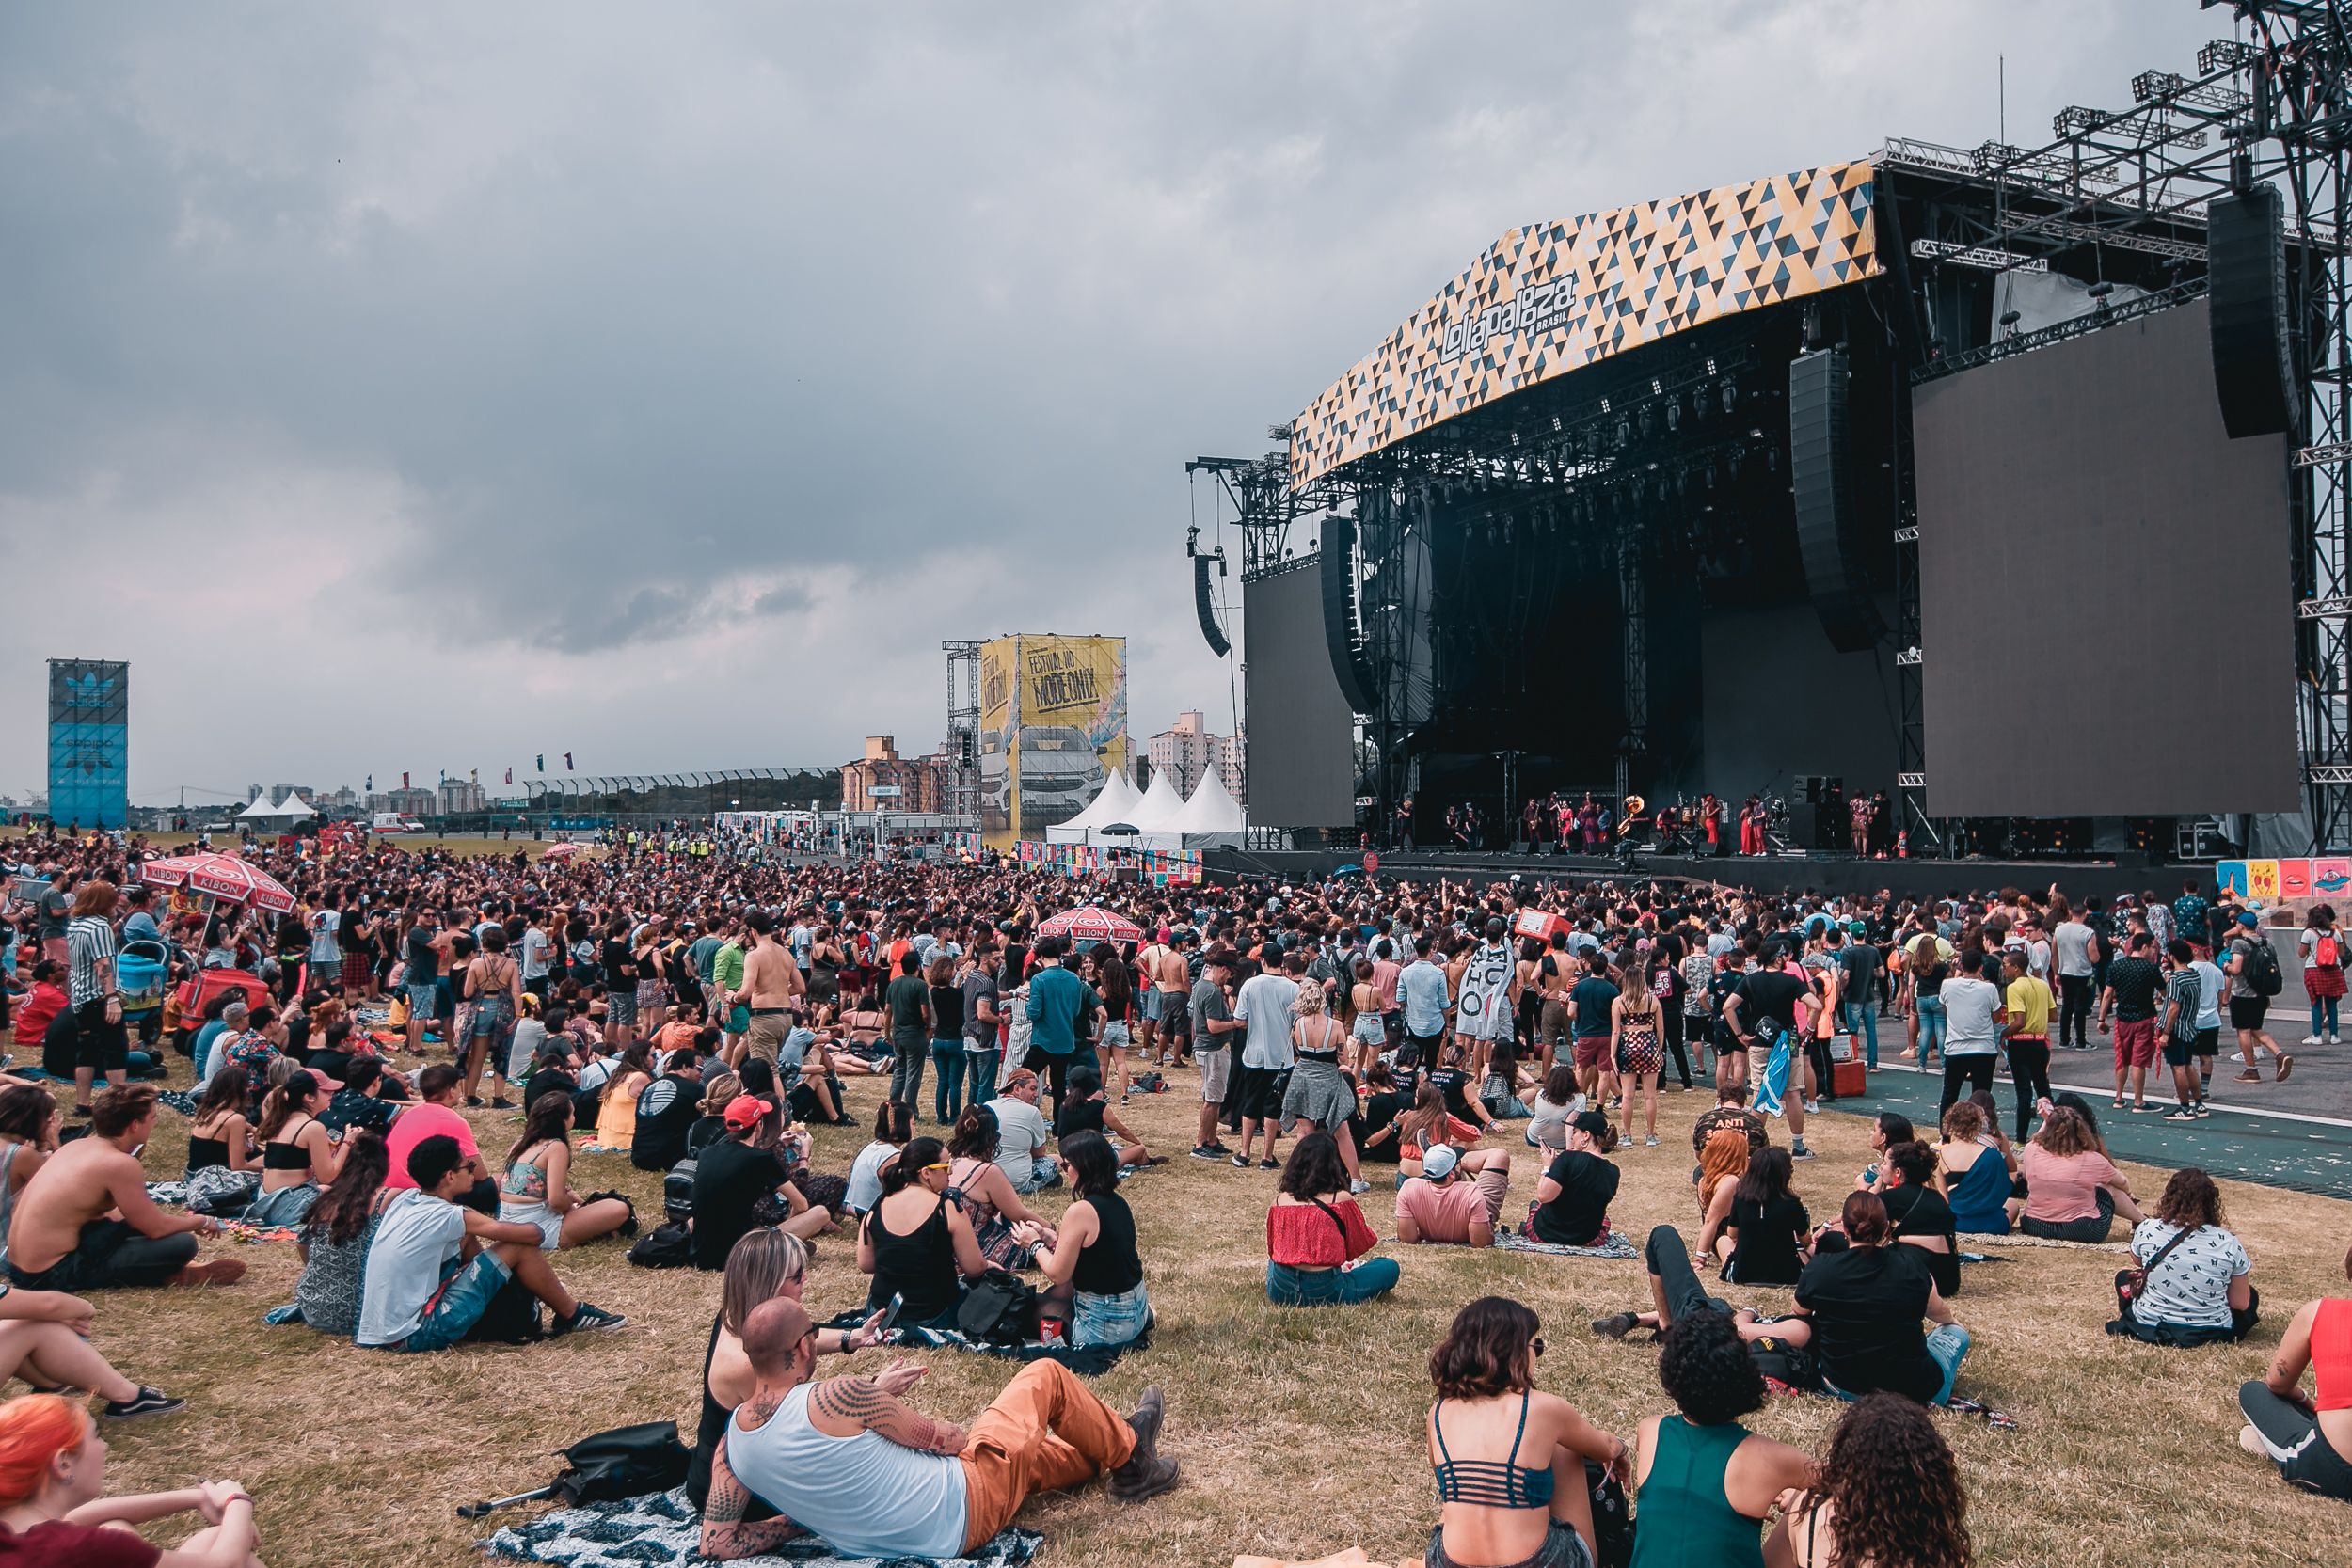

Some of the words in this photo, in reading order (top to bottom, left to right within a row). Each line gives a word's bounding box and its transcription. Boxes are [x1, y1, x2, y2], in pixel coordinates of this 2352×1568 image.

[1536, 312, 1567, 332] BRASIL
[1028, 652, 1063, 674] FESTIVAL
[1063, 650, 1075, 669] NO
[66, 698, 114, 707] adidas
[151, 867, 180, 880] KIBON
[200, 878, 239, 894] KIBON
[261, 893, 286, 907] KIBON
[1715, 1118, 1744, 1128] ANTI
